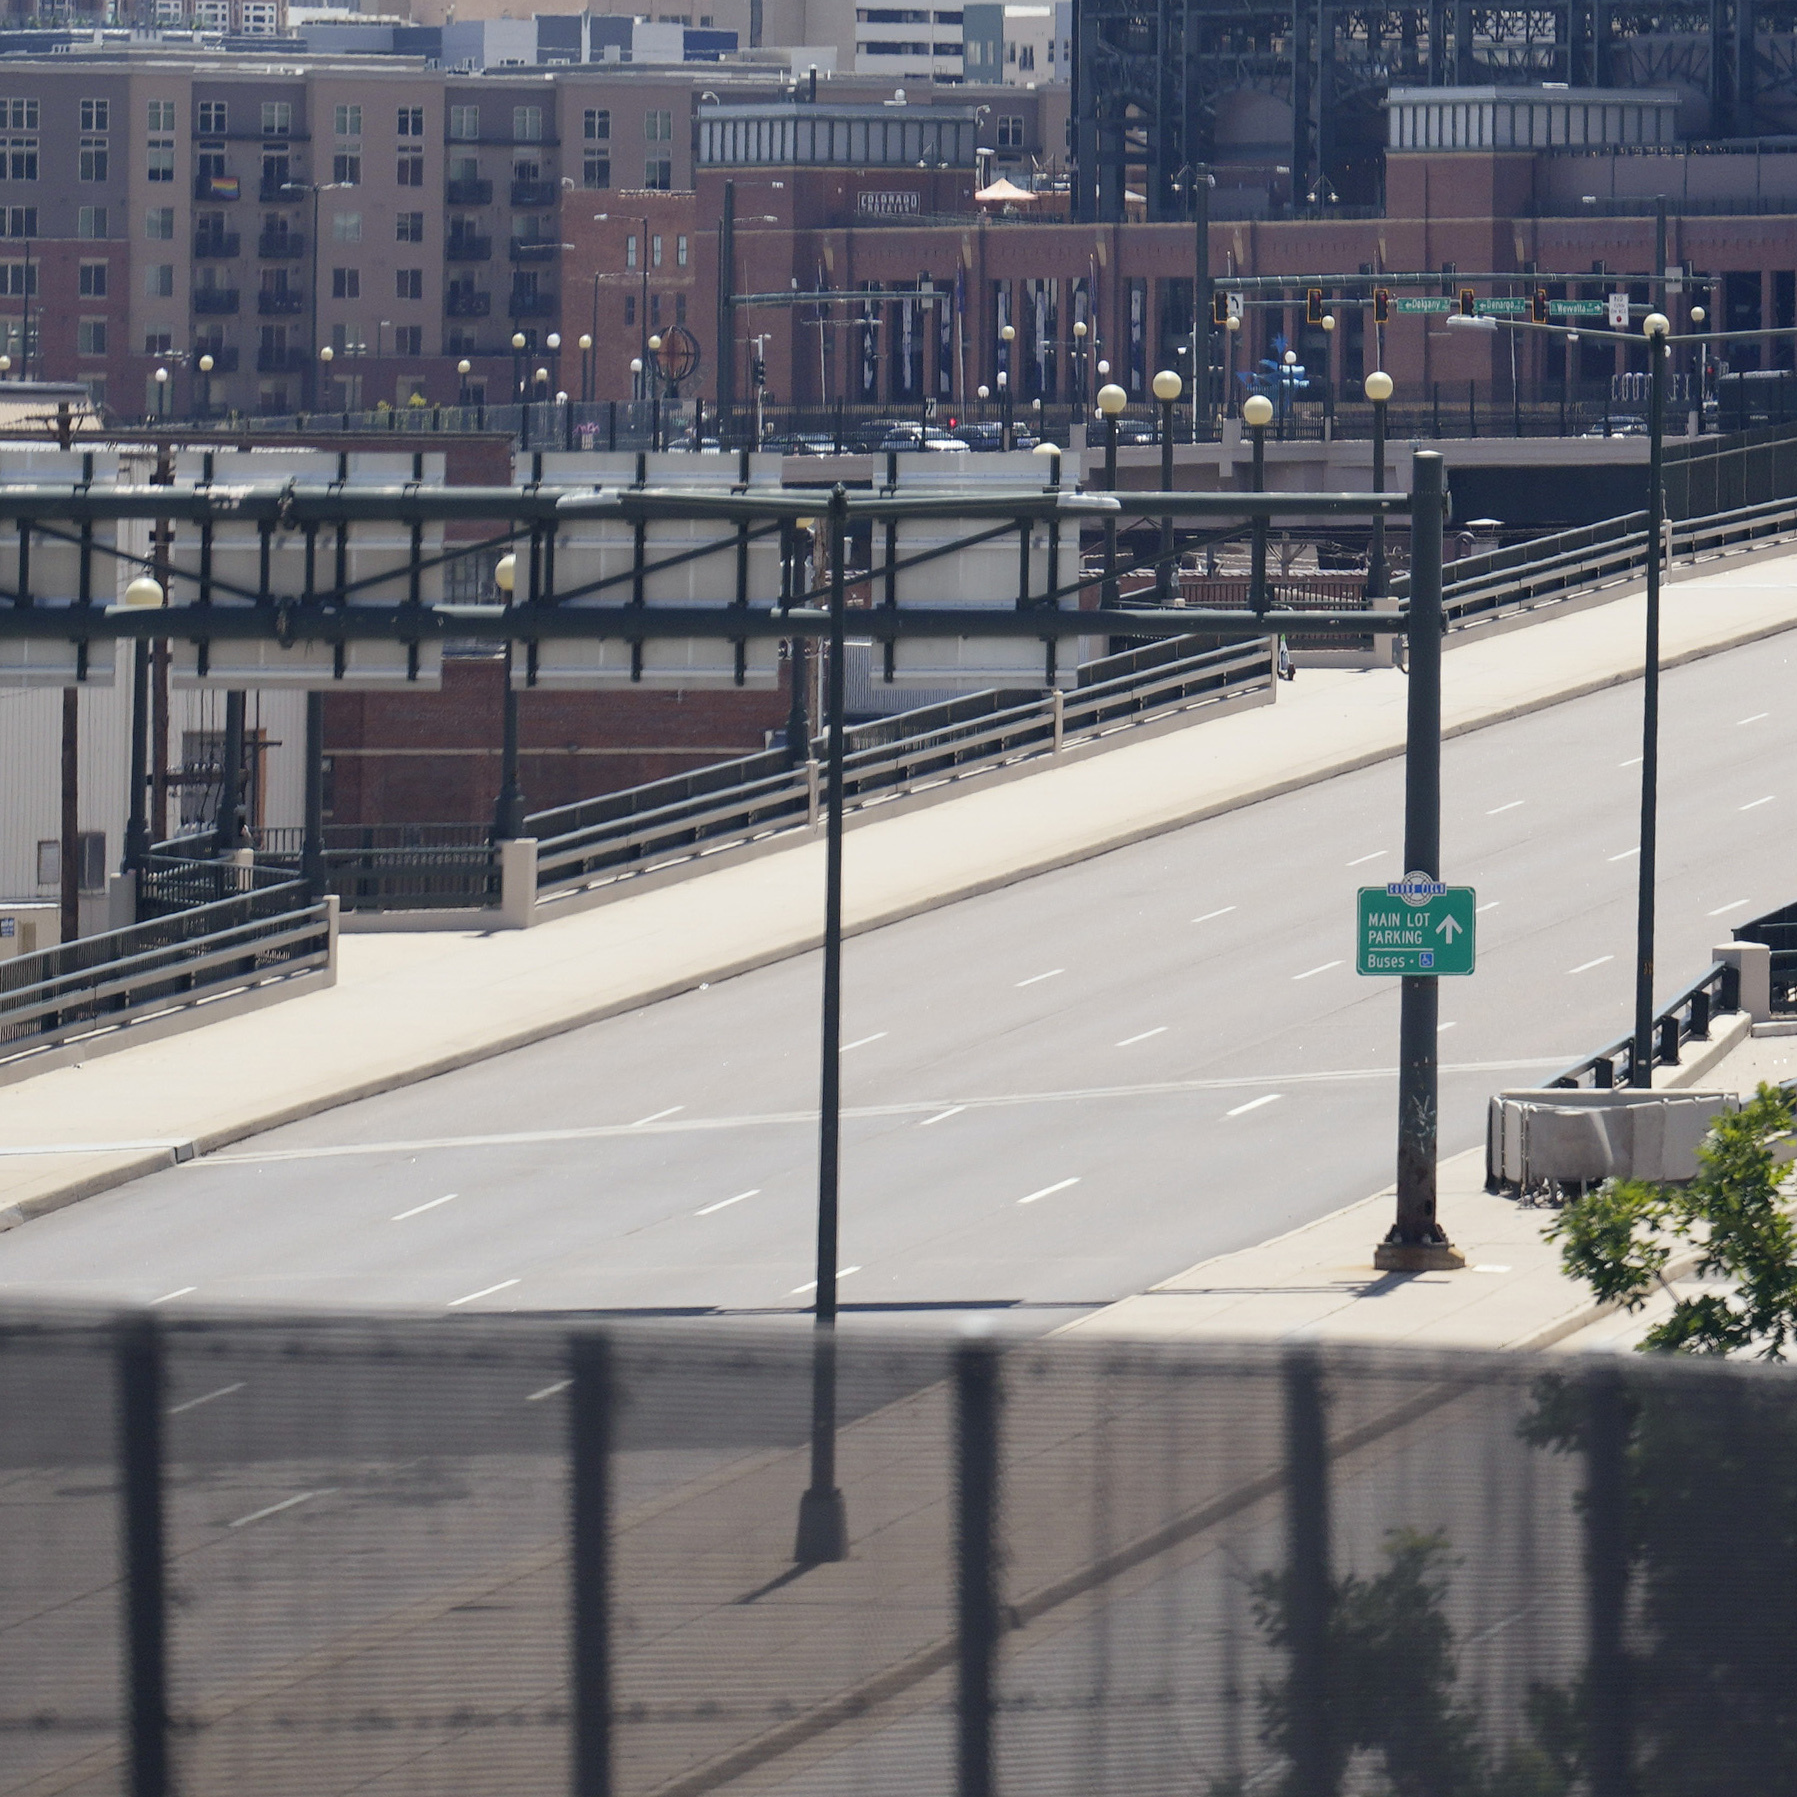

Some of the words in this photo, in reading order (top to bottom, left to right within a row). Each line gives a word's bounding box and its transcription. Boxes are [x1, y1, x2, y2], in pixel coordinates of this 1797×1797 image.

[861, 194, 917, 207] COLORADO
[1368, 913, 1400, 927] MAIN
[1407, 913, 1430, 927] LOT
[1368, 930, 1422, 944] PARKING
[1368, 954, 1405, 968] Buses
